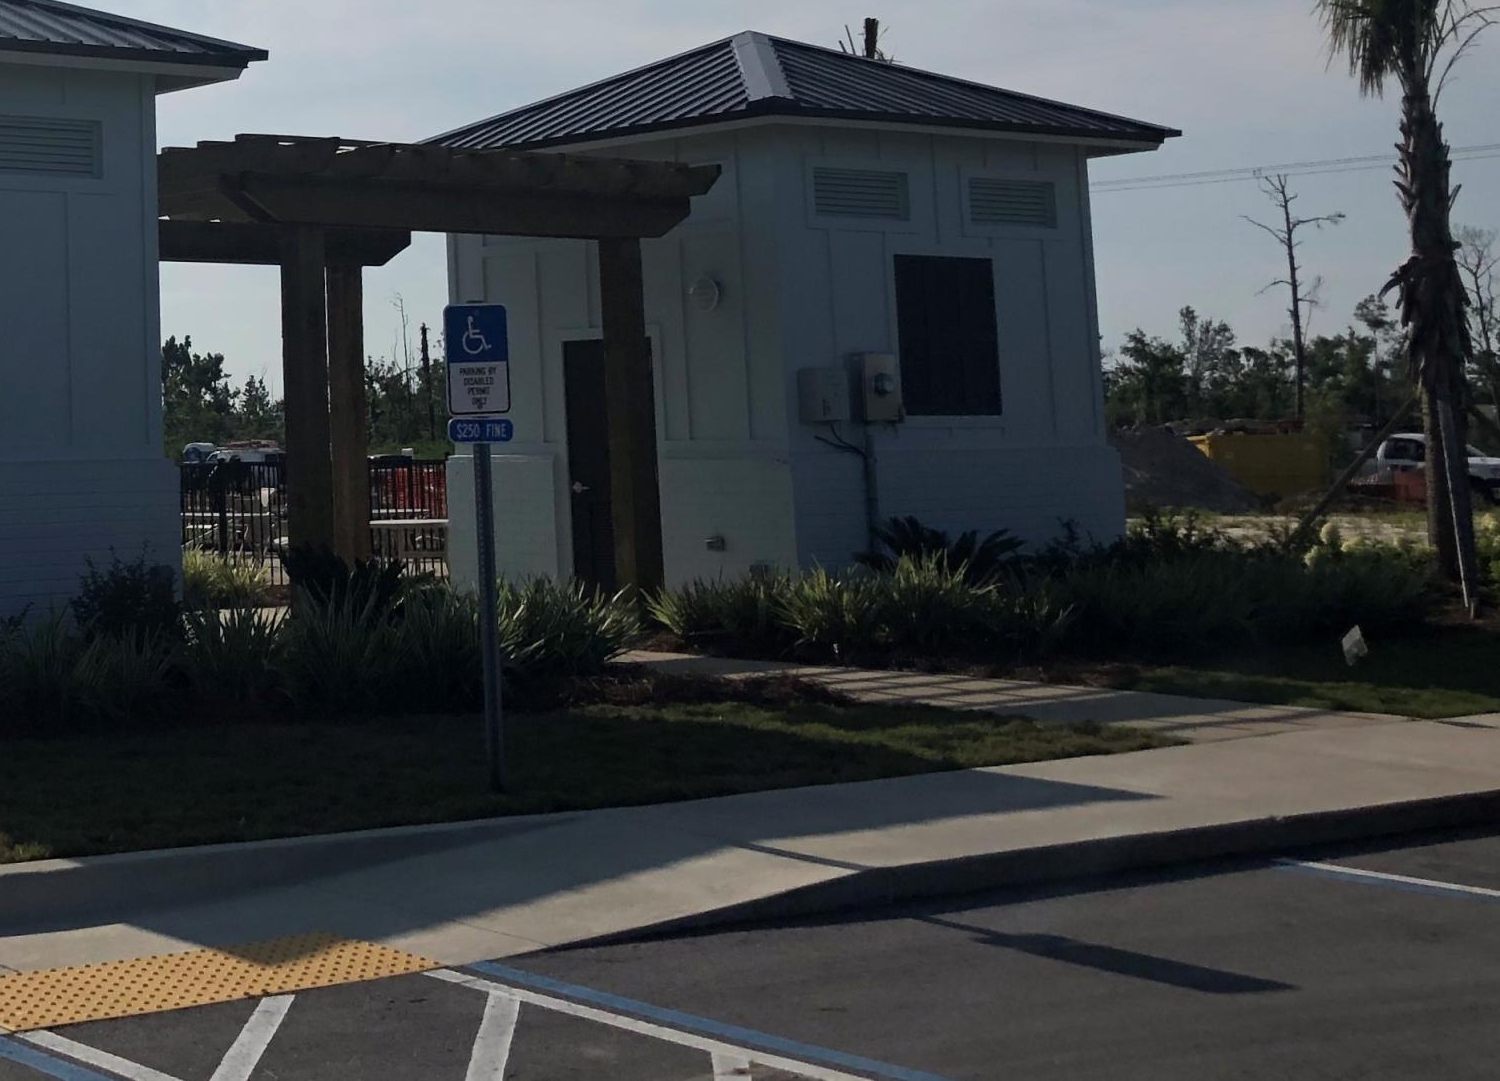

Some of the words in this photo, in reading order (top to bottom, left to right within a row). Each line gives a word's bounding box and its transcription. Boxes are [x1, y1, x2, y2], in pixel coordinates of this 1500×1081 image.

[459, 367, 486, 376] PARKING
[488, 366, 496, 375] BY
[463, 377, 494, 386] DISABLED
[456, 424, 479, 438] $250
[486, 424, 506, 437] FINE
